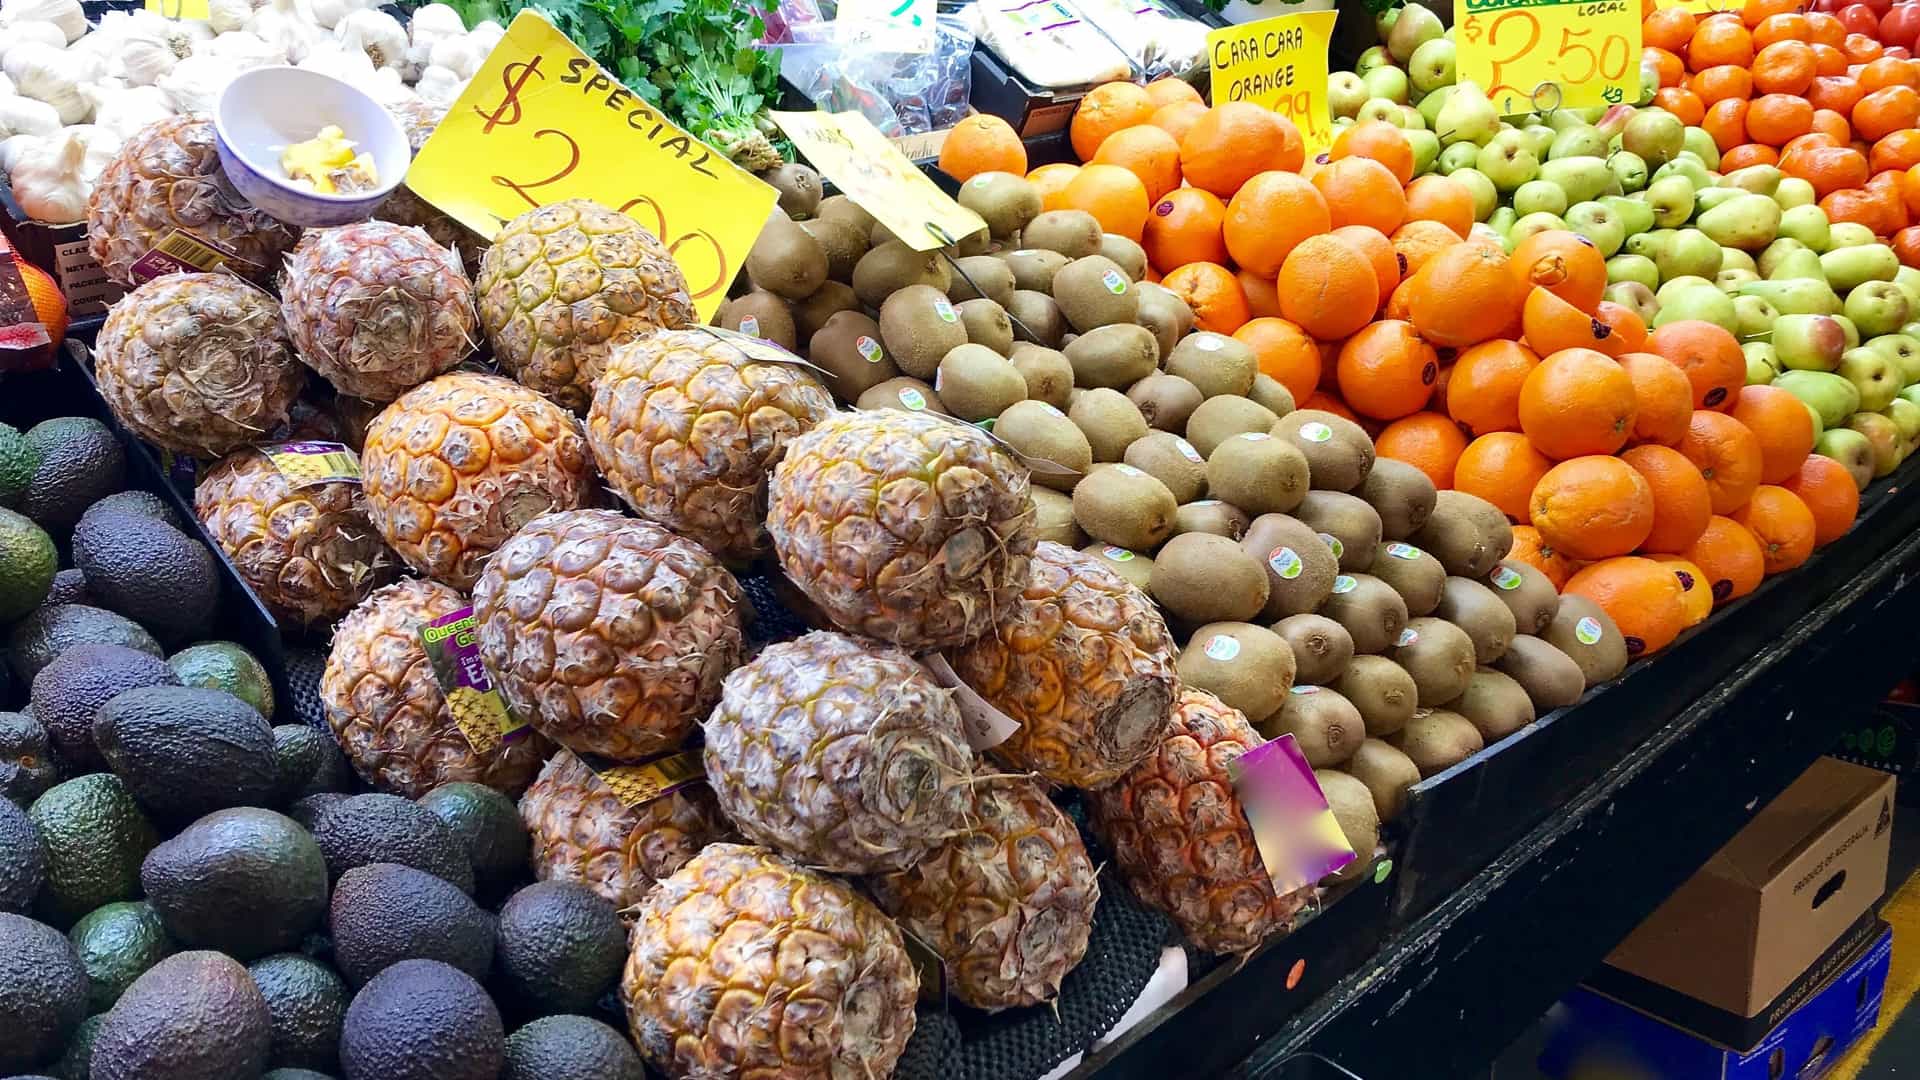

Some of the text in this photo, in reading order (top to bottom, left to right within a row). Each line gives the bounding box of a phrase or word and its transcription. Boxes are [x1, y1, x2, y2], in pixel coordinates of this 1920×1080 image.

[1577, 2, 1627, 17] LOCAL
[1214, 27, 1303, 70] CARA CARA
[1229, 64, 1295, 102] ORANGE
[560, 58, 719, 180] SPECIAL
[456, 632, 478, 647] Go
